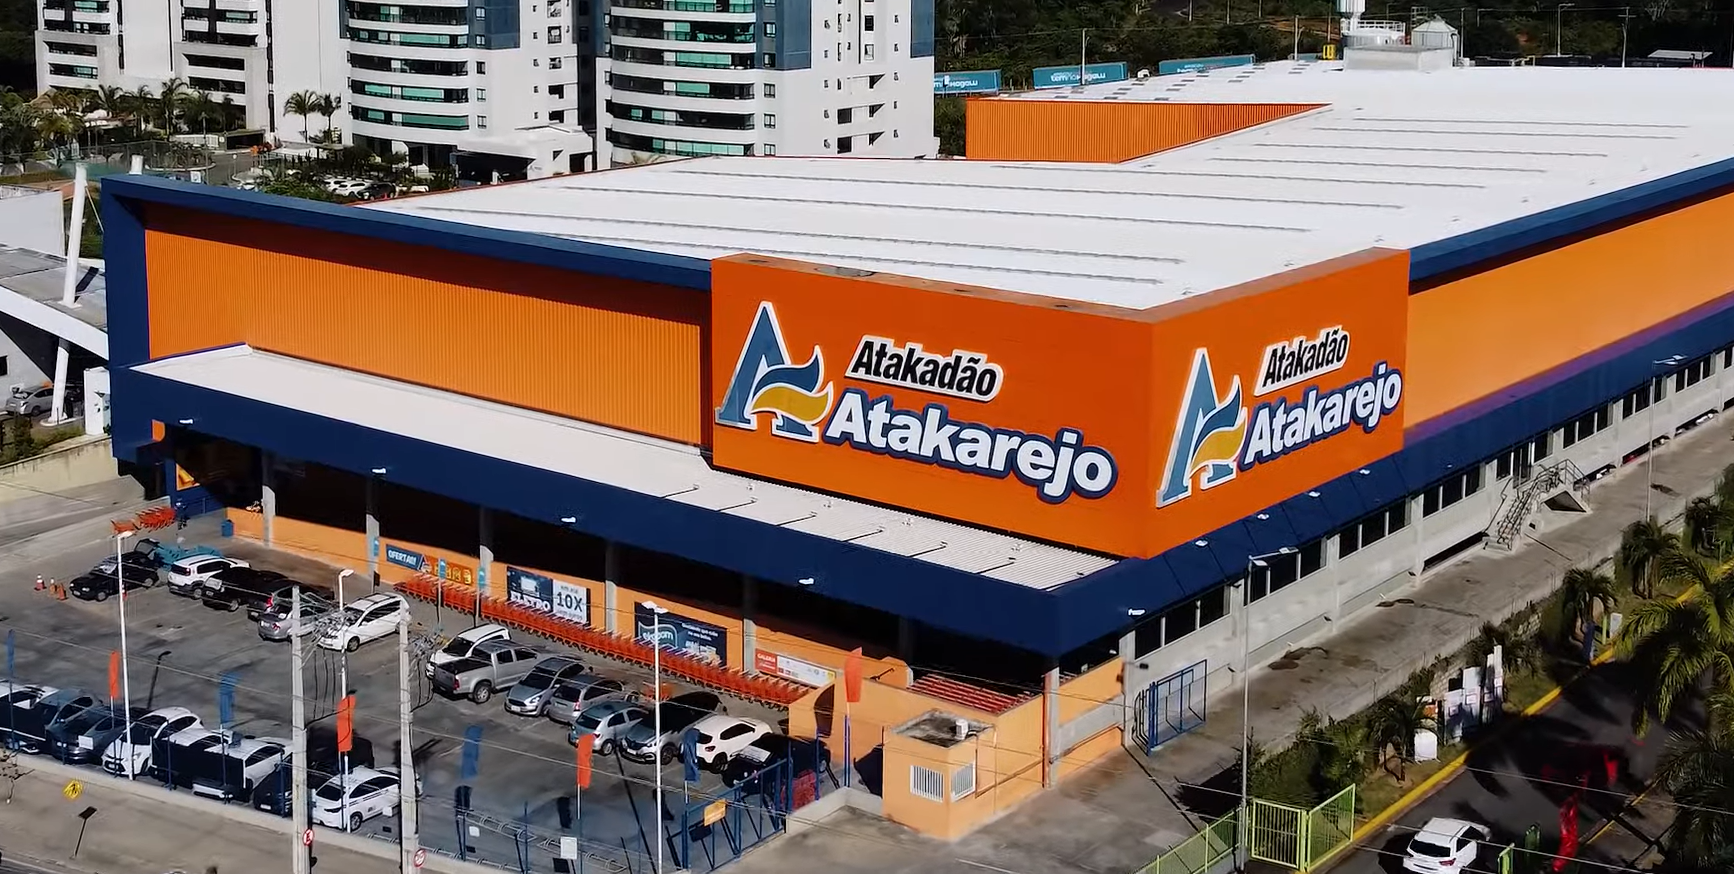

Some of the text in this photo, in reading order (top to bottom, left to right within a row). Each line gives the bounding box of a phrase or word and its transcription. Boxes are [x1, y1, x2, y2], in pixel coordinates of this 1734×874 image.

[850, 339, 999, 398] Atakadão
[1262, 327, 1349, 388] Atakadão
[1243, 362, 1403, 465] Atakarejo
[824, 391, 1113, 498] Atakarejo
[556, 591, 583, 613] 10X
